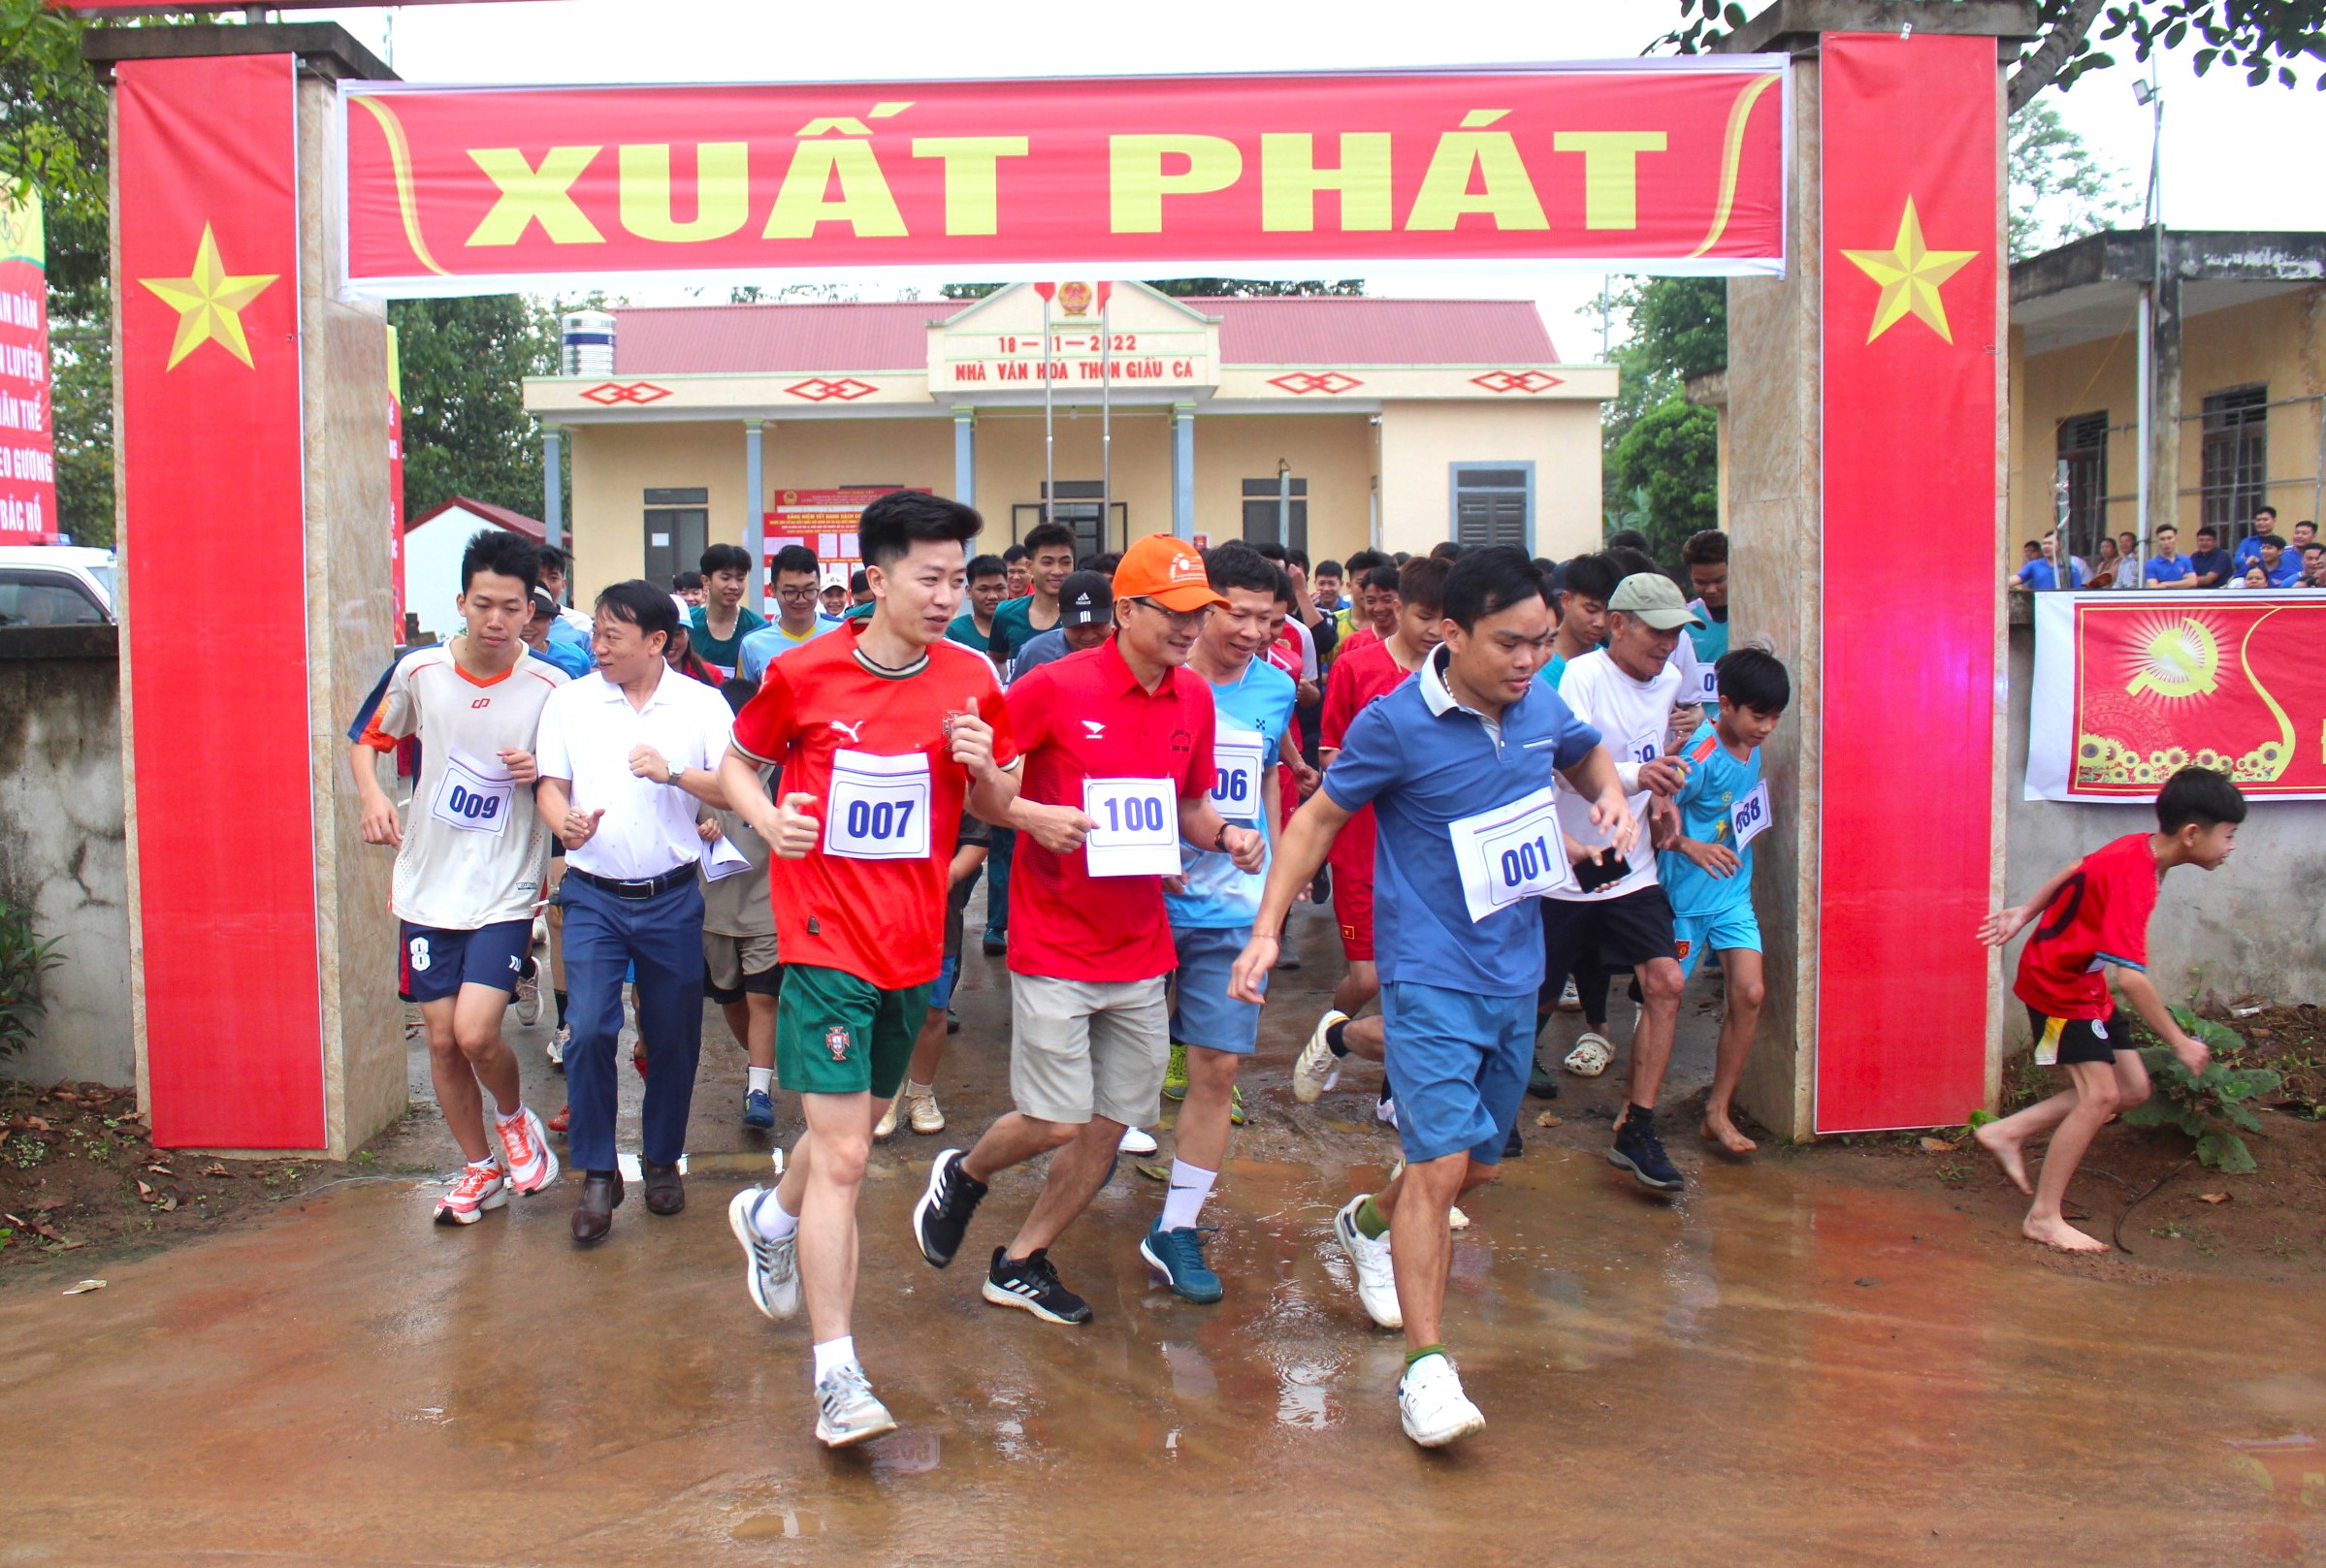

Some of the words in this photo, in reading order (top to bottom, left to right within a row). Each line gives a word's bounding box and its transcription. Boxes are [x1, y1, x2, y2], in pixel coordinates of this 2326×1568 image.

[464, 102, 1029, 247] XUẤT
[1110, 109, 1667, 234] PHÁT
[13, 291, 39, 331] DÂN
[998, 336, 1016, 353] 18
[6, 342, 45, 387] LUYỆN
[997, 358, 1028, 380] VĂN
[19, 389, 43, 432] THỂ
[14, 446, 53, 484] GƯƠNG
[0, 493, 24, 531] BÁC
[449, 784, 501, 819] 009
[848, 799, 915, 840] 007
[1104, 797, 1164, 832] 100
[1502, 835, 1551, 887] 001
[409, 936, 431, 972] 8
